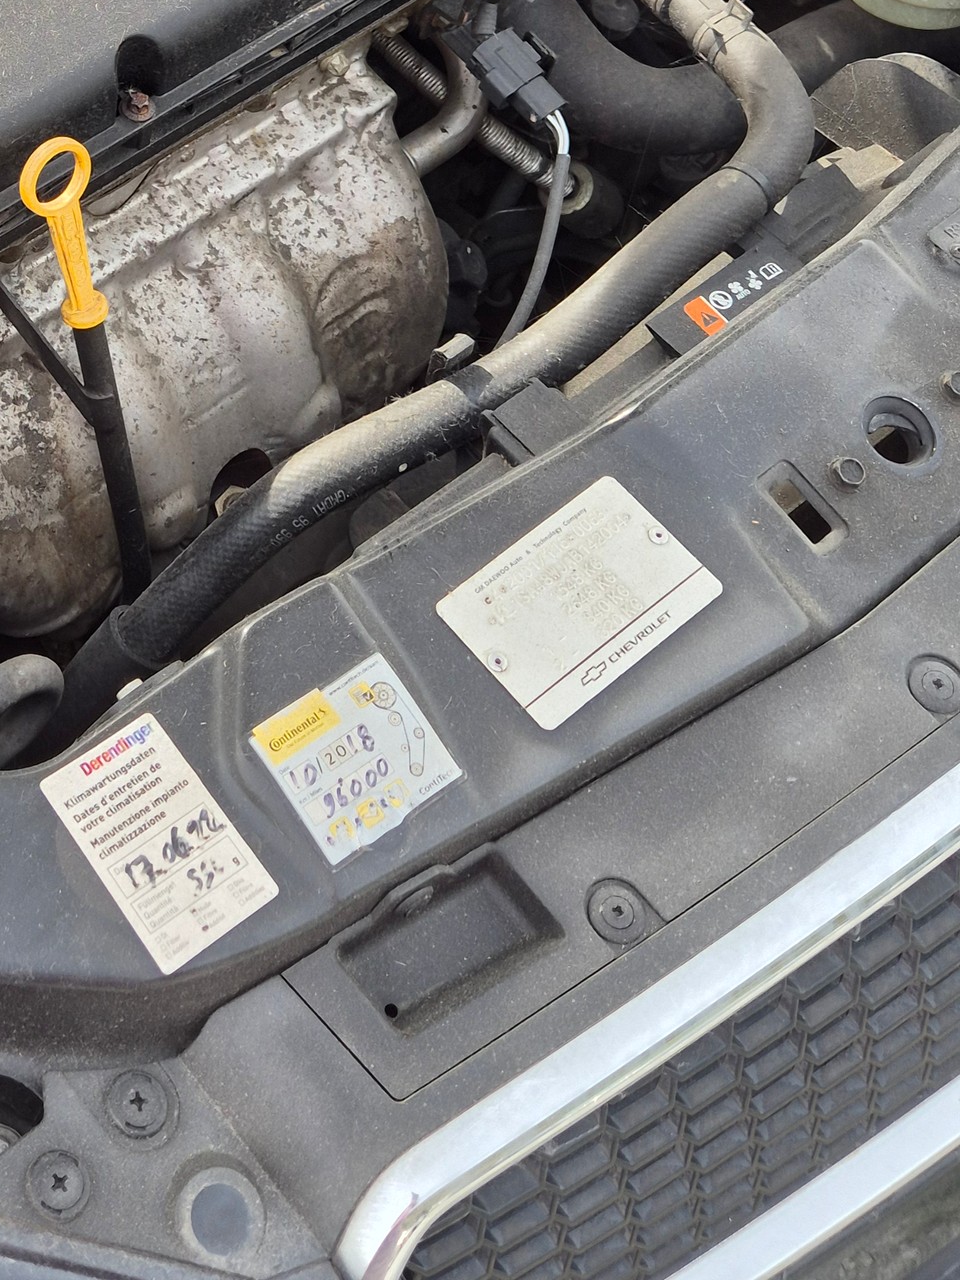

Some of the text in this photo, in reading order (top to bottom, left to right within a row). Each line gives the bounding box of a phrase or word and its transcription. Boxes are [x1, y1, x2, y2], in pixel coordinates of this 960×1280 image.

[736, 289, 751, 300] AUTO
[473, 583, 486, 594] GM
[482, 564, 511, 587] DAEWOO
[508, 554, 524, 568] Auto
[532, 524, 563, 550] Technology
[561, 505, 588, 528] Company
[580, 555, 604, 578] KG
[593, 568, 618, 591] KG
[605, 581, 631, 605] KG
[619, 595, 645, 619] KG
[607, 609, 672, 665] CHEVROLET
[80, 721, 155, 776] Derendinger
[268, 707, 322, 752] Continental
[63, 745, 156, 810] Klimawartungsdaten
[71, 759, 162, 824] Dates d'entretien de
[78, 773, 163, 834] votre climatisation
[88, 776, 191, 850] Manutenzione impianto
[96, 808, 168, 860] climatizzazione
[231, 855, 241, 866] g
